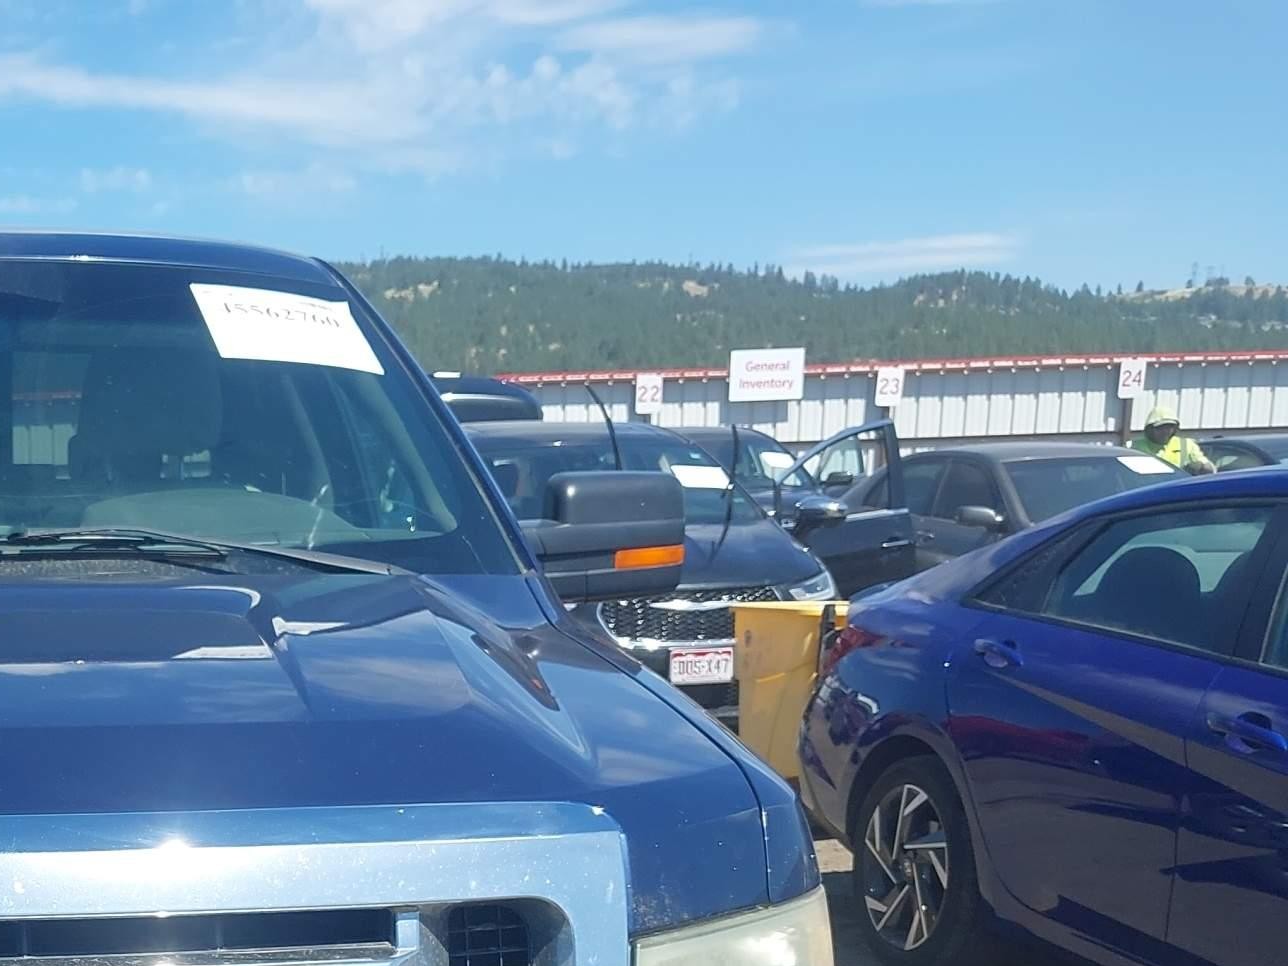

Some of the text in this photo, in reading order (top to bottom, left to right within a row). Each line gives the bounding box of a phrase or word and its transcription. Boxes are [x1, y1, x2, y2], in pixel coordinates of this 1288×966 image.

[745, 360, 790, 372] General
[739, 379, 794, 391] Inventory
[879, 377, 899, 395] 23
[1122, 369, 1143, 388] 24
[638, 385, 659, 403] 22
